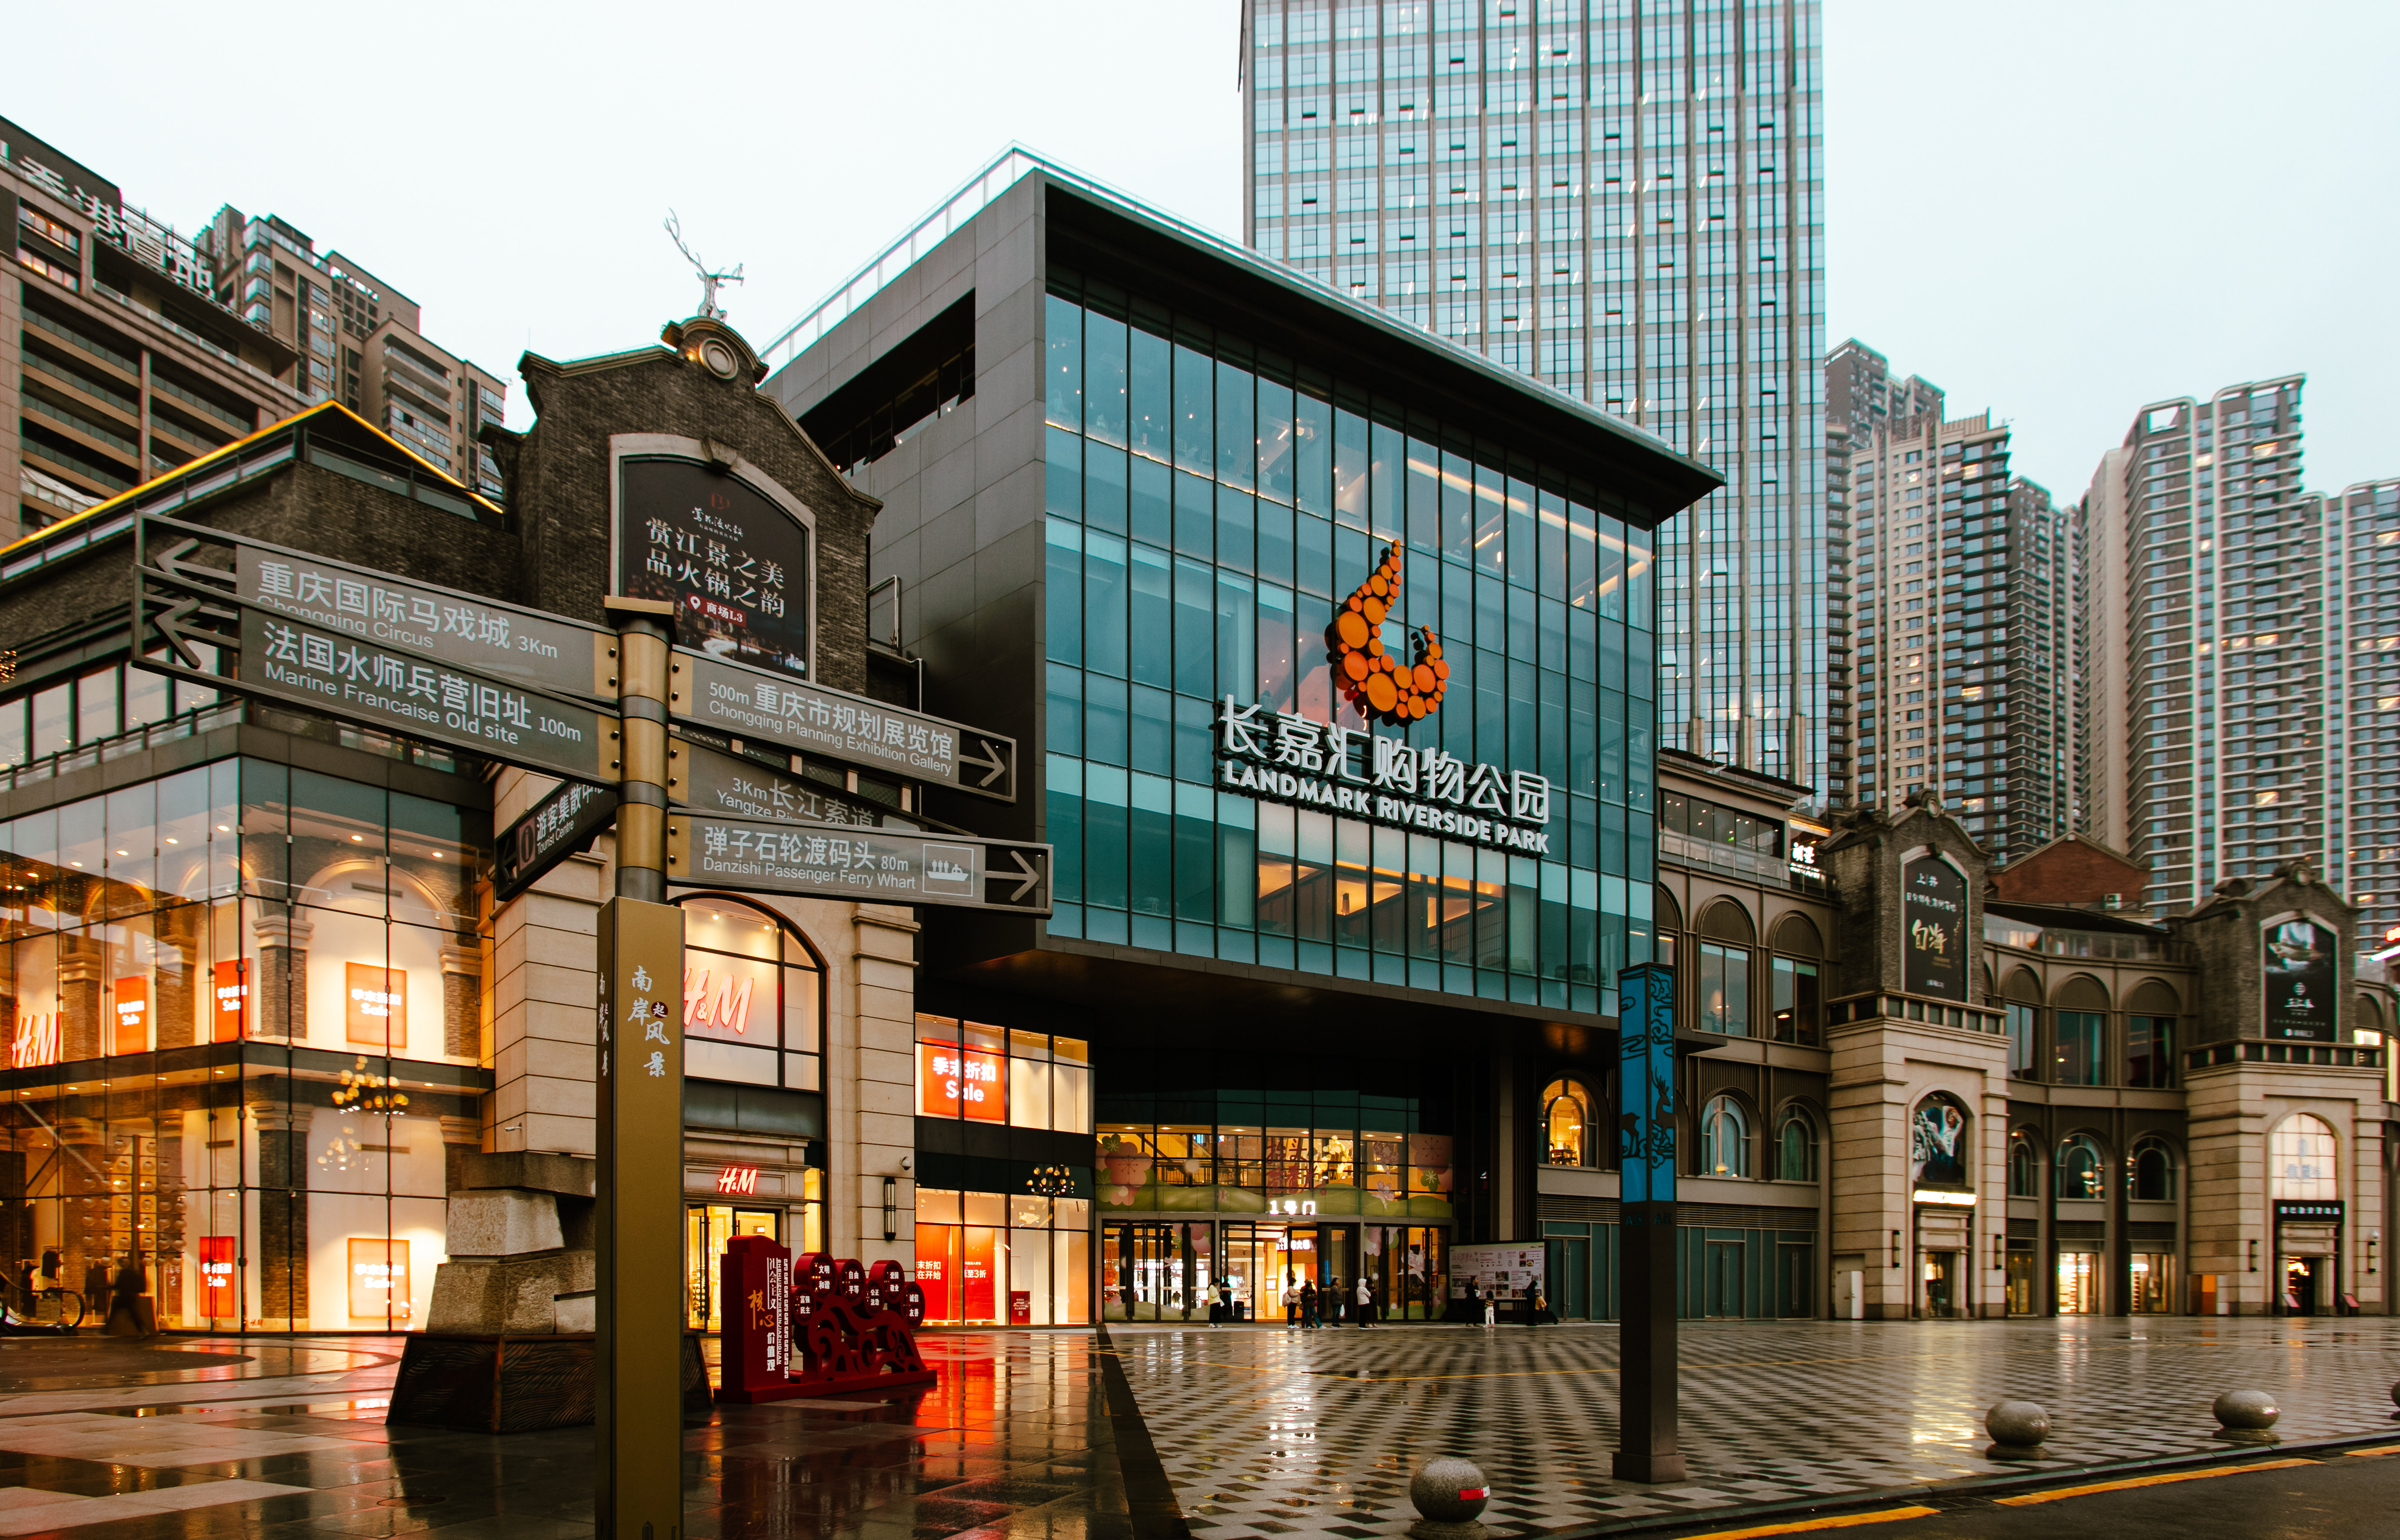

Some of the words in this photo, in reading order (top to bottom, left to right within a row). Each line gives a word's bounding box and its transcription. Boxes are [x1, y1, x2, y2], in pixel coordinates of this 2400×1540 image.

[646, 516, 785, 590] 赏江景之美
[646, 547, 785, 618] 品火锅之韵
[258, 561, 510, 650] 重庆国际马戏城
[518, 634, 558, 659] 3Km
[706, 602, 743, 623] 商场L3
[374, 622, 434, 648] Circus
[264, 621, 531, 730] 法国水师兵营旧址
[539, 715, 581, 742] 100m
[265, 661, 337, 696] Marine
[345, 684, 439, 724] Francaise
[446, 712, 480, 735] Old
[484, 722, 518, 745] site
[709, 682, 749, 705] 500m
[754, 683, 952, 761] 重庆市规划展览馆
[709, 701, 782, 733] Chongqing
[787, 722, 843, 749] Planning
[847, 736, 906, 762] Exhibition
[910, 753, 951, 776] Gallery
[1218, 694, 1549, 825] 长嘉汇购物公园
[717, 790, 772, 818] Yangtze
[733, 778, 767, 801] 3Km
[769, 779, 874, 827] 长江索道
[1224, 760, 1370, 814] LANDMARK
[1377, 796, 1491, 841] RIVERSIDE
[1495, 823, 1549, 855] PARK
[537, 834, 554, 854] Tourist
[556, 820, 574, 841] Centre
[704, 827, 875, 870] 弹子石轮渡码头
[881, 856, 908, 871] 80m
[703, 857, 761, 876] Danzishi
[766, 862, 836, 886] Passenger
[840, 870, 873, 888] Ferry
[683, 967, 754, 1035] H&M
[12, 1012, 61, 1068] H&M
[933, 1057, 996, 1082] 季末折扣
[946, 1079, 984, 1102] Sale
[718, 1167, 758, 1195] H&M
[1270, 1201, 1315, 1215] 1号门
[1625, 1214, 1644, 1226] A区
[819, 1265, 829, 1274] 文明
[849, 1271, 859, 1279] 自由
[916, 1260, 941, 1270] 末折扣
[916, 1270, 941, 1280] 在开始
[819, 1281, 830, 1289] 和谐
[849, 1285, 859, 1294] 平等
[909, 1309, 919, 1317] 友善
[748, 1289, 775, 1330] 核心
[767, 1332, 775, 1371] 价值观
